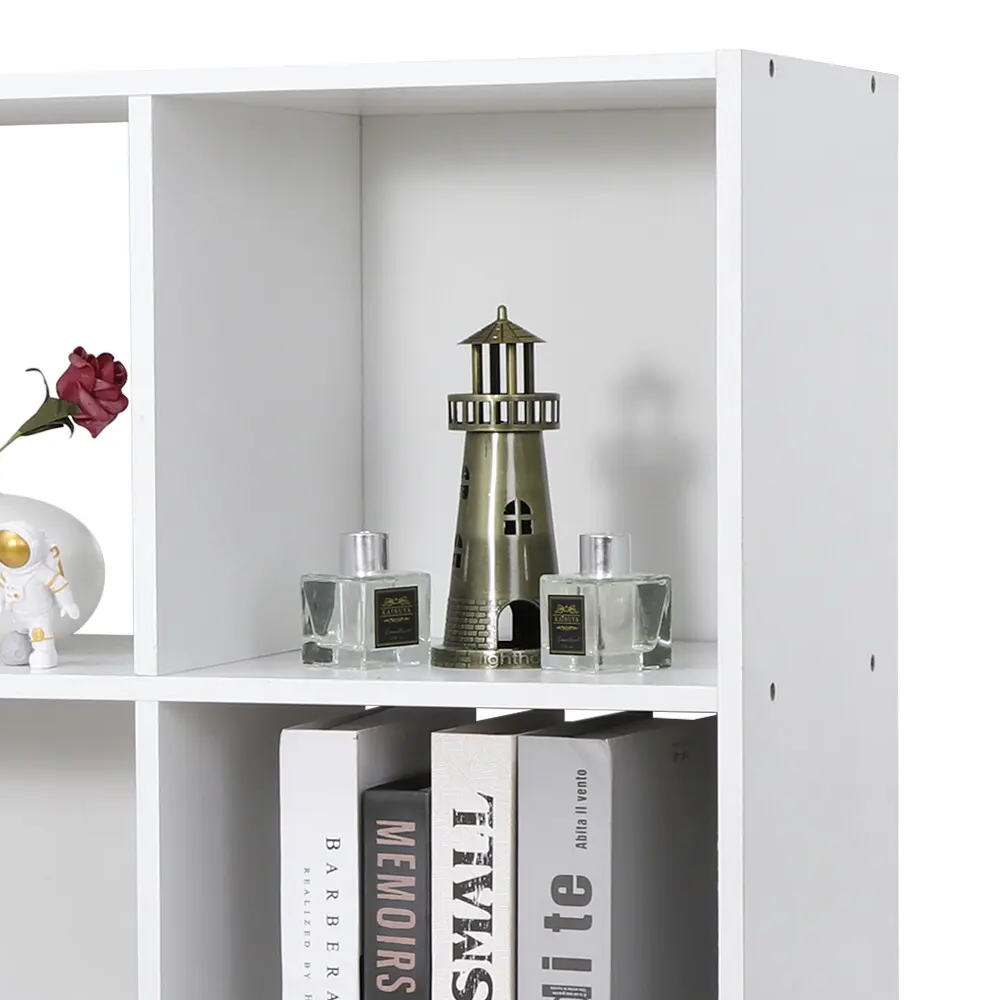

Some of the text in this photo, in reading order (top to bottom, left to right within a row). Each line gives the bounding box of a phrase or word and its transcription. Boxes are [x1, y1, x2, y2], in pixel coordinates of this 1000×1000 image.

[575, 768, 588, 802] vento
[575, 818, 588, 850] Abita
[303, 867, 311, 948] REALIZED
[376, 820, 417, 994] MEMOIRS
[543, 873, 593, 933] te
[304, 962, 311, 980] BY
